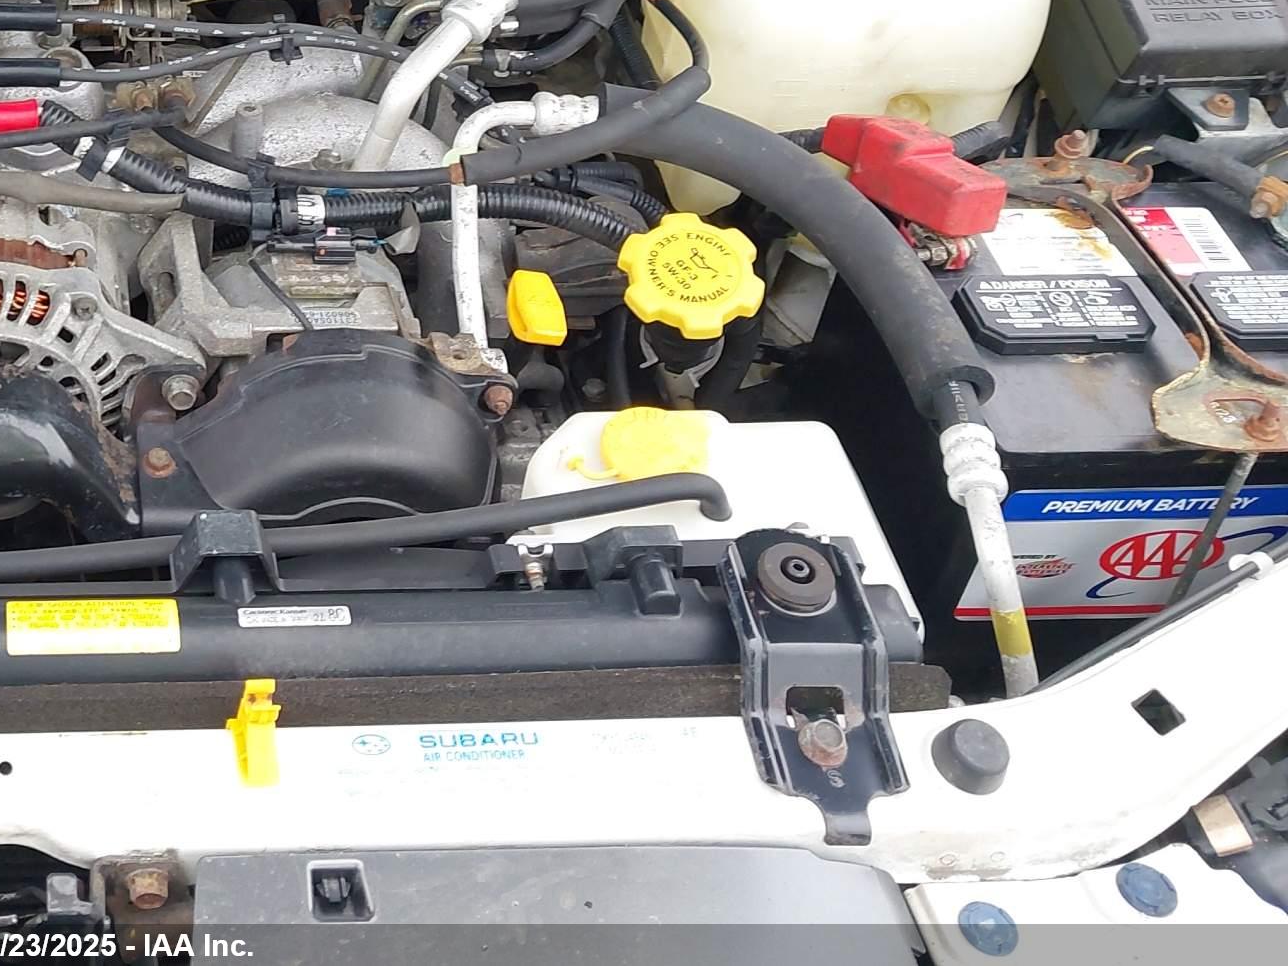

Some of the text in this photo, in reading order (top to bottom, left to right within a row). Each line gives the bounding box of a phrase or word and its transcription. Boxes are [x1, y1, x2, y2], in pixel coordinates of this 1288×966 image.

[1152, 10, 1285, 23] RELAY BOX
[679, 286, 730, 303] MANUAL
[1042, 497, 1151, 514] PREMIUM
[419, 732, 539, 748] SUBARU
[424, 750, 526, 762] AIR CONDITIONER
